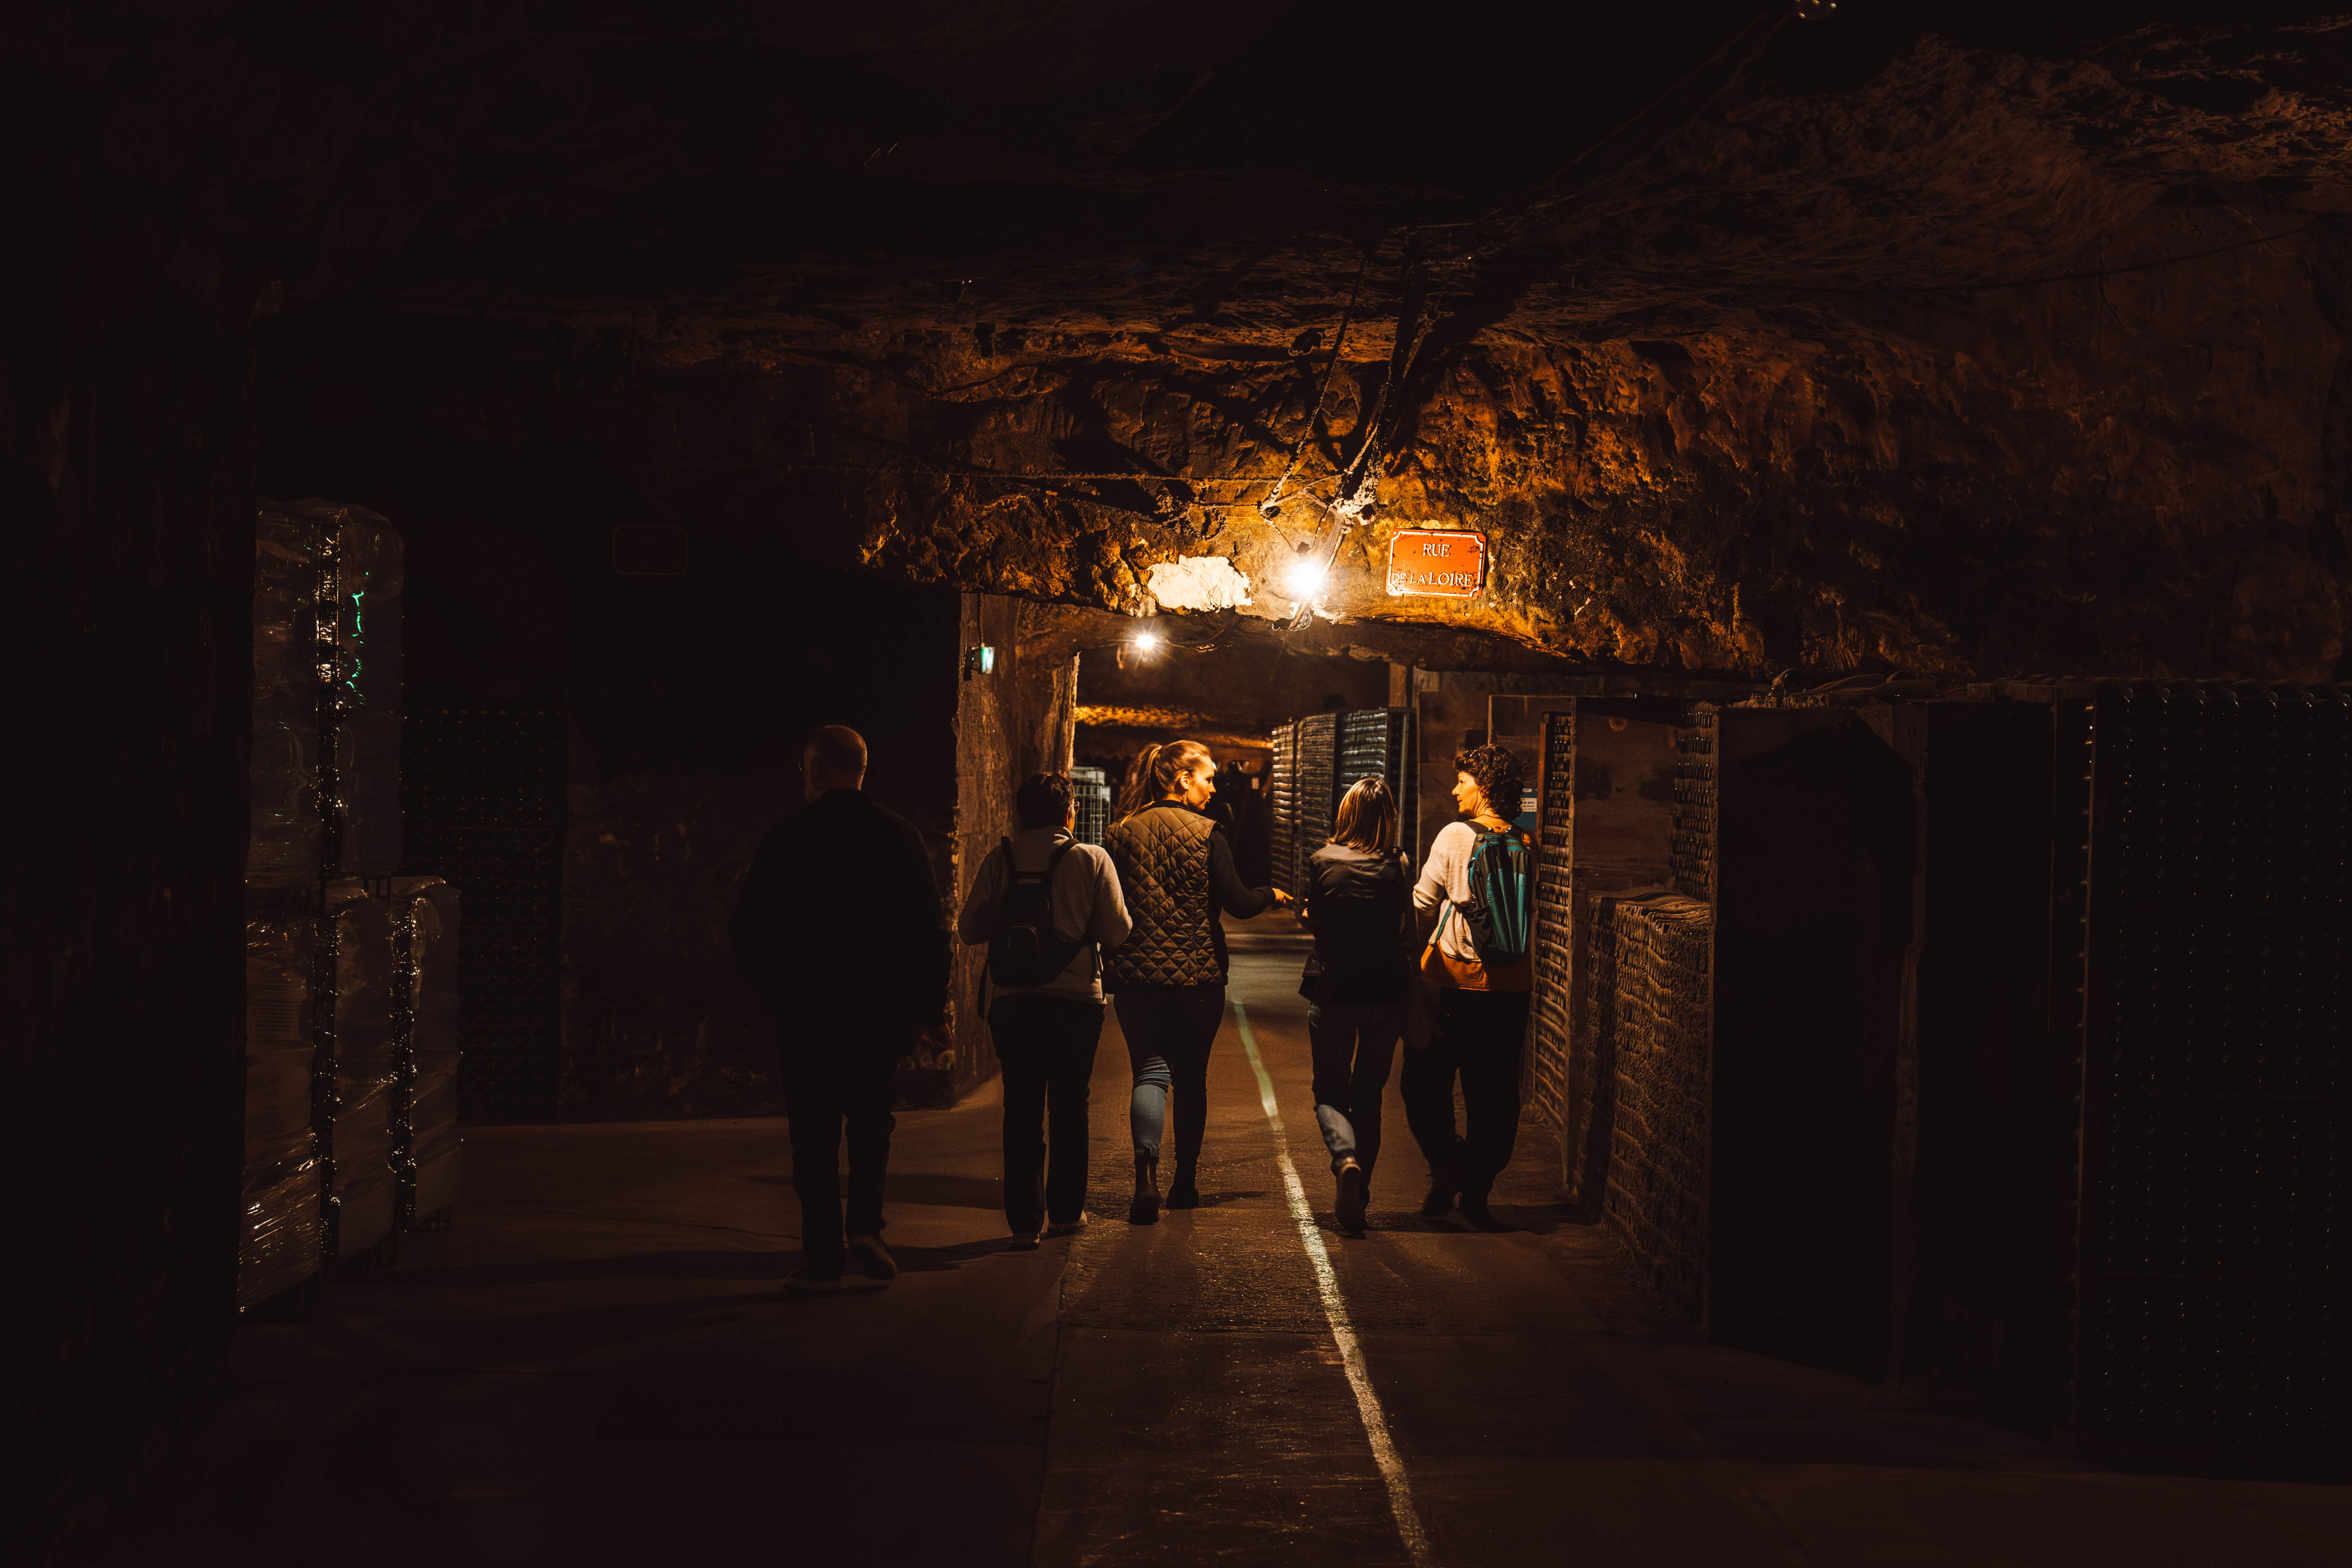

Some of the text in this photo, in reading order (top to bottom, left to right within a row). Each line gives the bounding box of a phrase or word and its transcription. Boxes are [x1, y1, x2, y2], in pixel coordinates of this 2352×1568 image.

[1423, 543, 1450, 556] RUE
[1393, 572, 1473, 586] DE LA LOIRE
